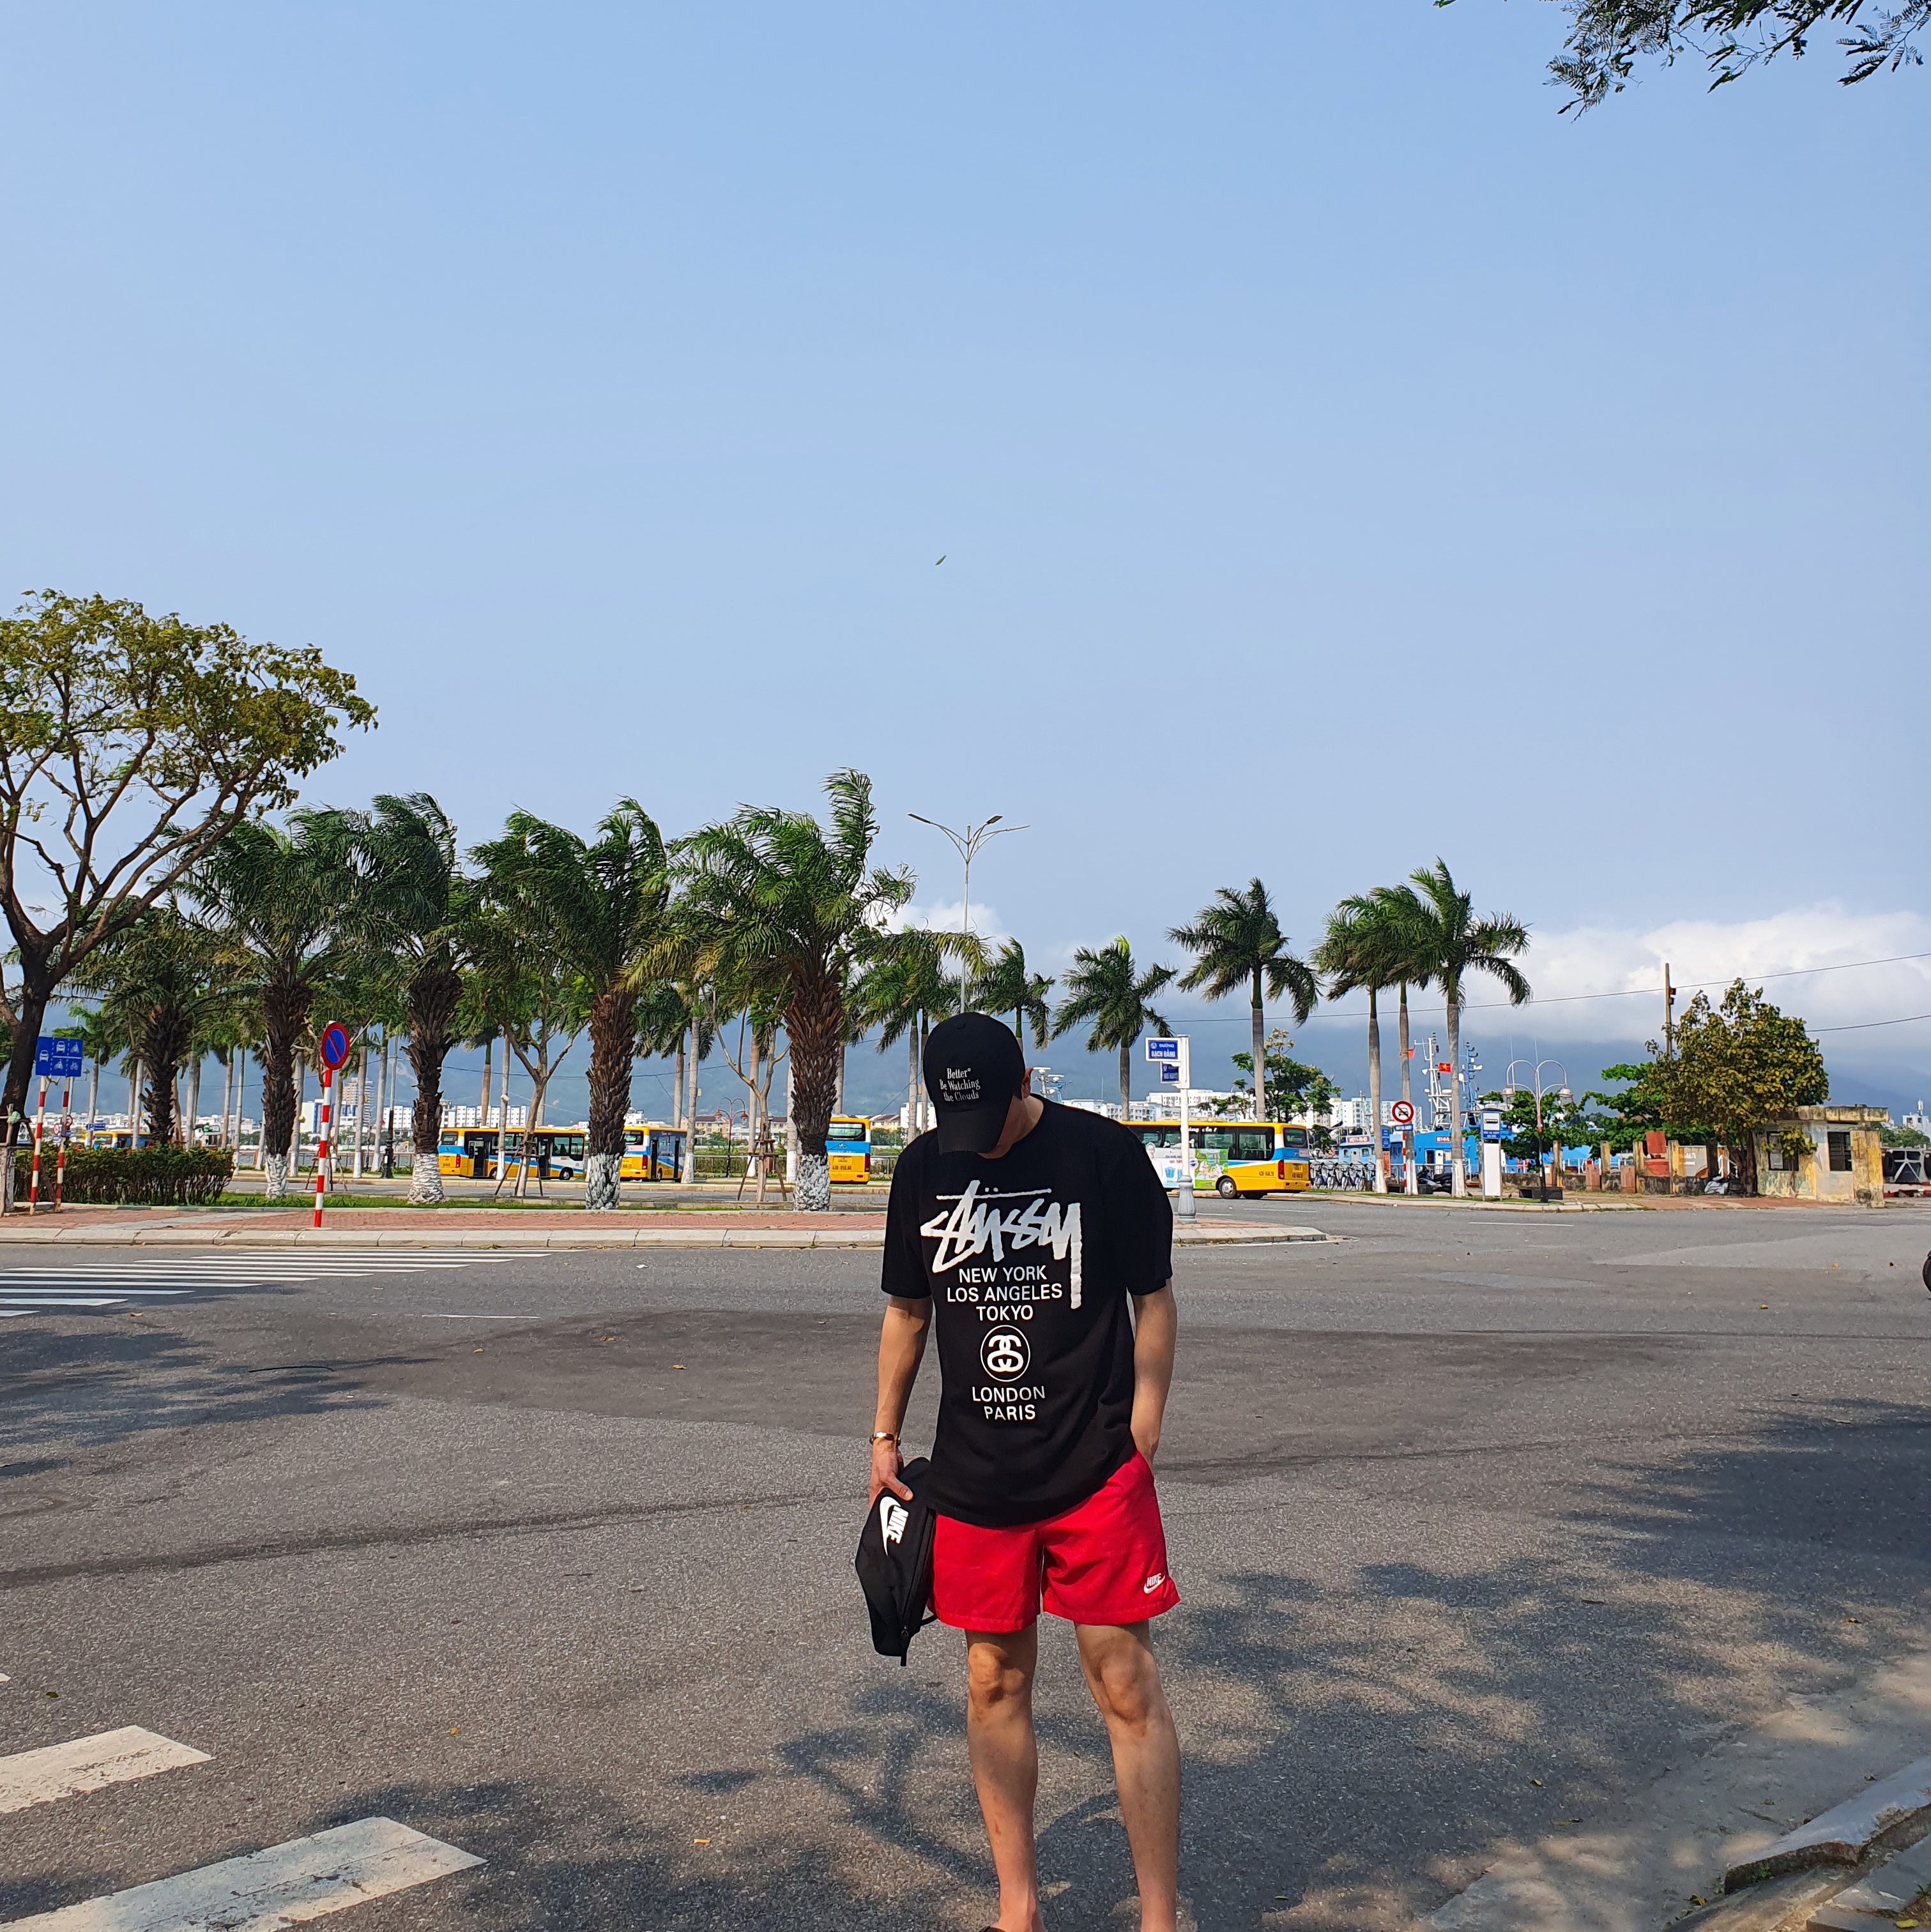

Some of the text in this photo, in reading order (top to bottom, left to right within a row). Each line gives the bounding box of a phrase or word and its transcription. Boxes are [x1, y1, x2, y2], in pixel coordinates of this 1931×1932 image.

[947, 1067, 968, 1079] Better
[939, 1079, 981, 1091] Be Watching
[943, 1089, 979, 1102] the Clouds
[959, 1265, 1048, 1283] NEW YORK
[947, 1282, 1063, 1302] LOS ANGELES
[976, 1304, 1034, 1321] TOKYO
[972, 1385, 1046, 1403] LONDON
[984, 1404, 1036, 1421] PARIS
[887, 1505, 909, 1544] NIKE
[1147, 1572, 1162, 1587] NIKE
